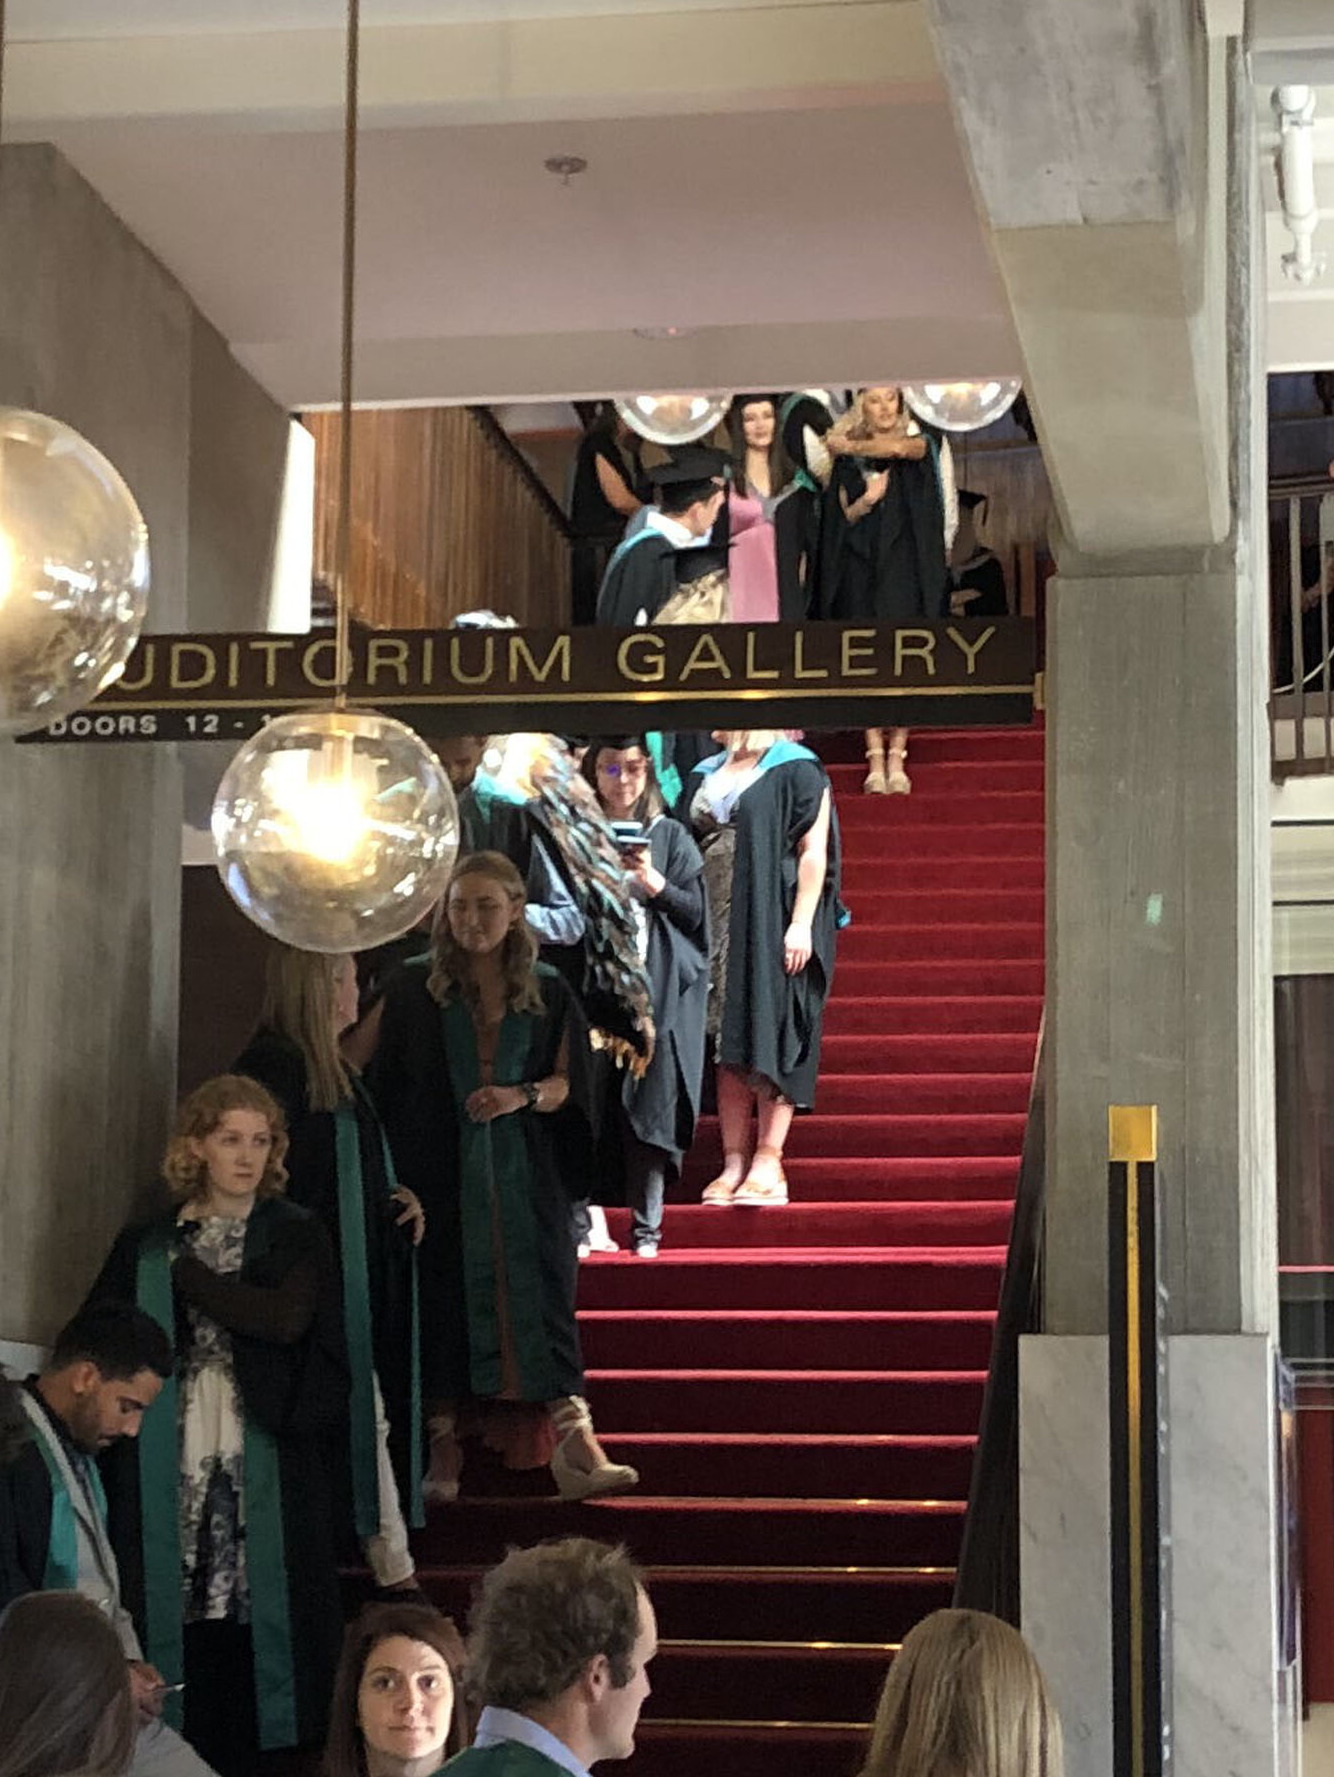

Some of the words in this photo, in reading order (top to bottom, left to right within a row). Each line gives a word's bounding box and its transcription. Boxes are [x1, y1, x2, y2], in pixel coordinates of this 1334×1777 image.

[103, 634, 572, 690] UDITORIUM
[616, 625, 996, 682] GALLERY
[49, 714, 158, 737] DOORS
[185, 714, 220, 734] 12
